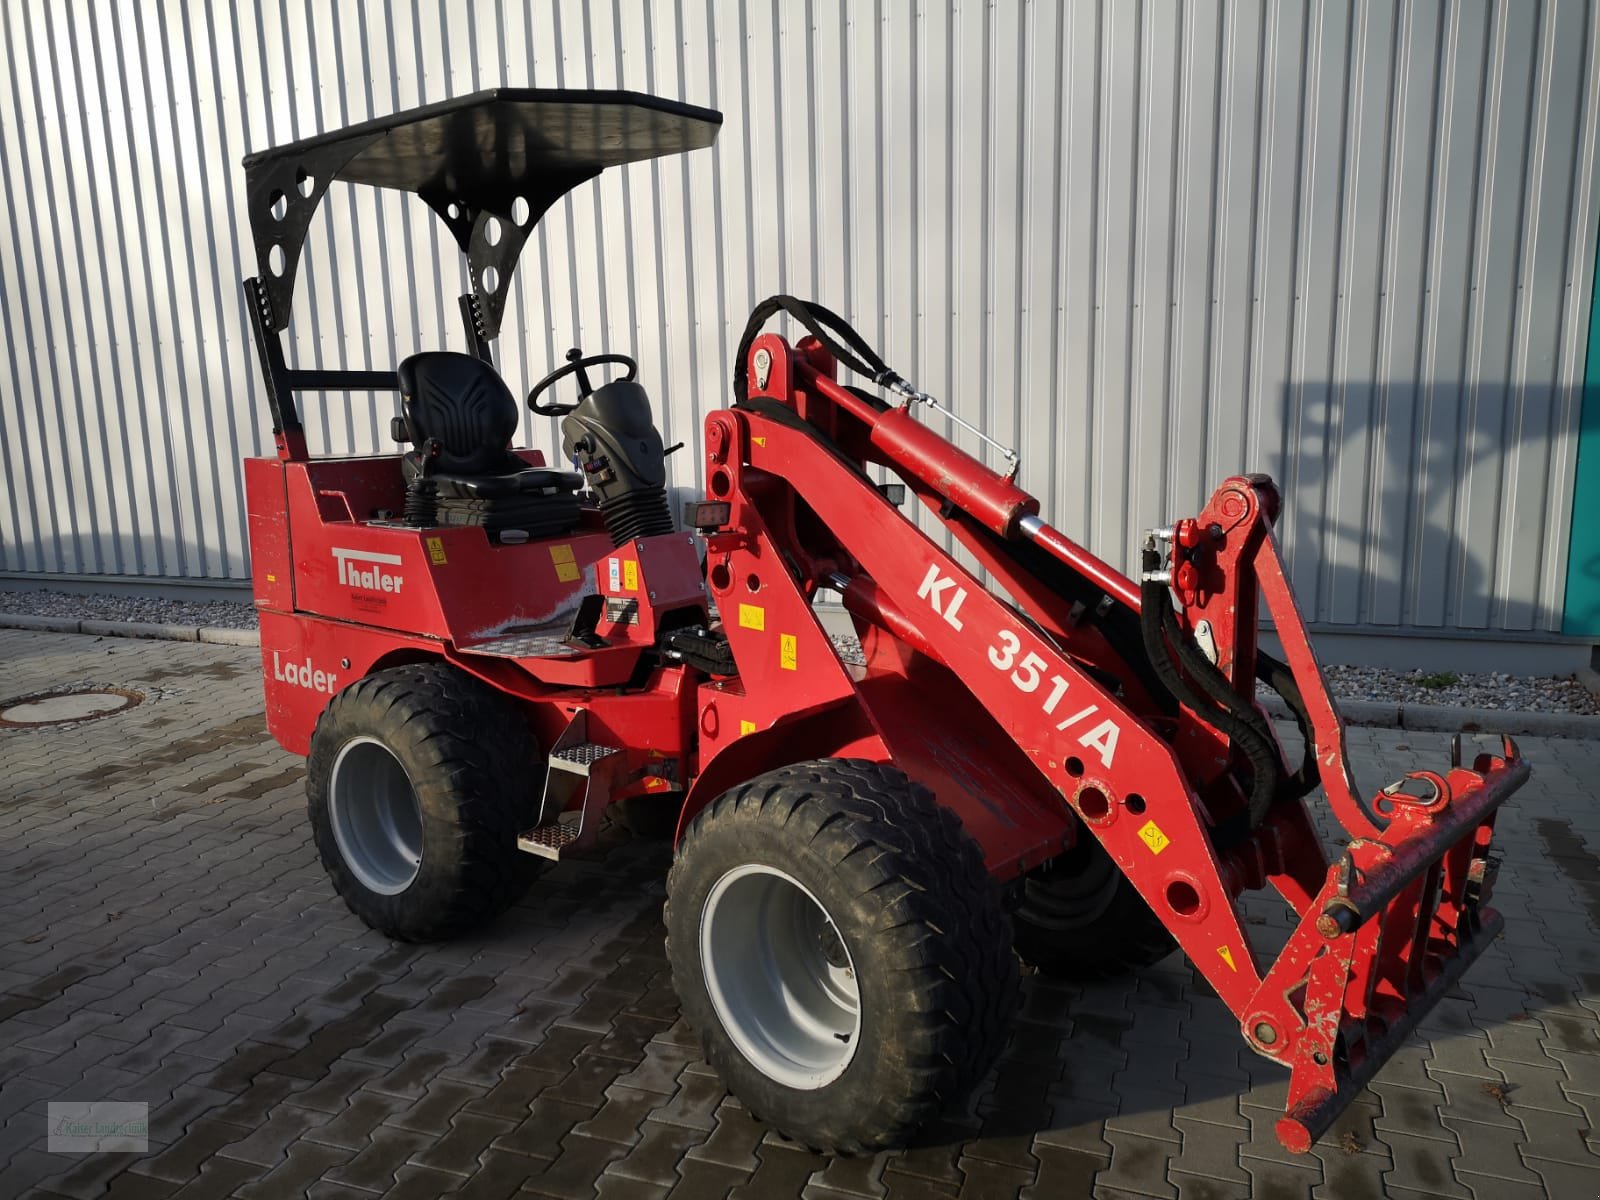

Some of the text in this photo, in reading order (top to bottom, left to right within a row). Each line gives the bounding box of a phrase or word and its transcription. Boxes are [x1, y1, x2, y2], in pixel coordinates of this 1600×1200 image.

[332, 547, 403, 593] Thaler
[273, 651, 337, 694] Lader
[917, 564, 1121, 769] KL 351/A
